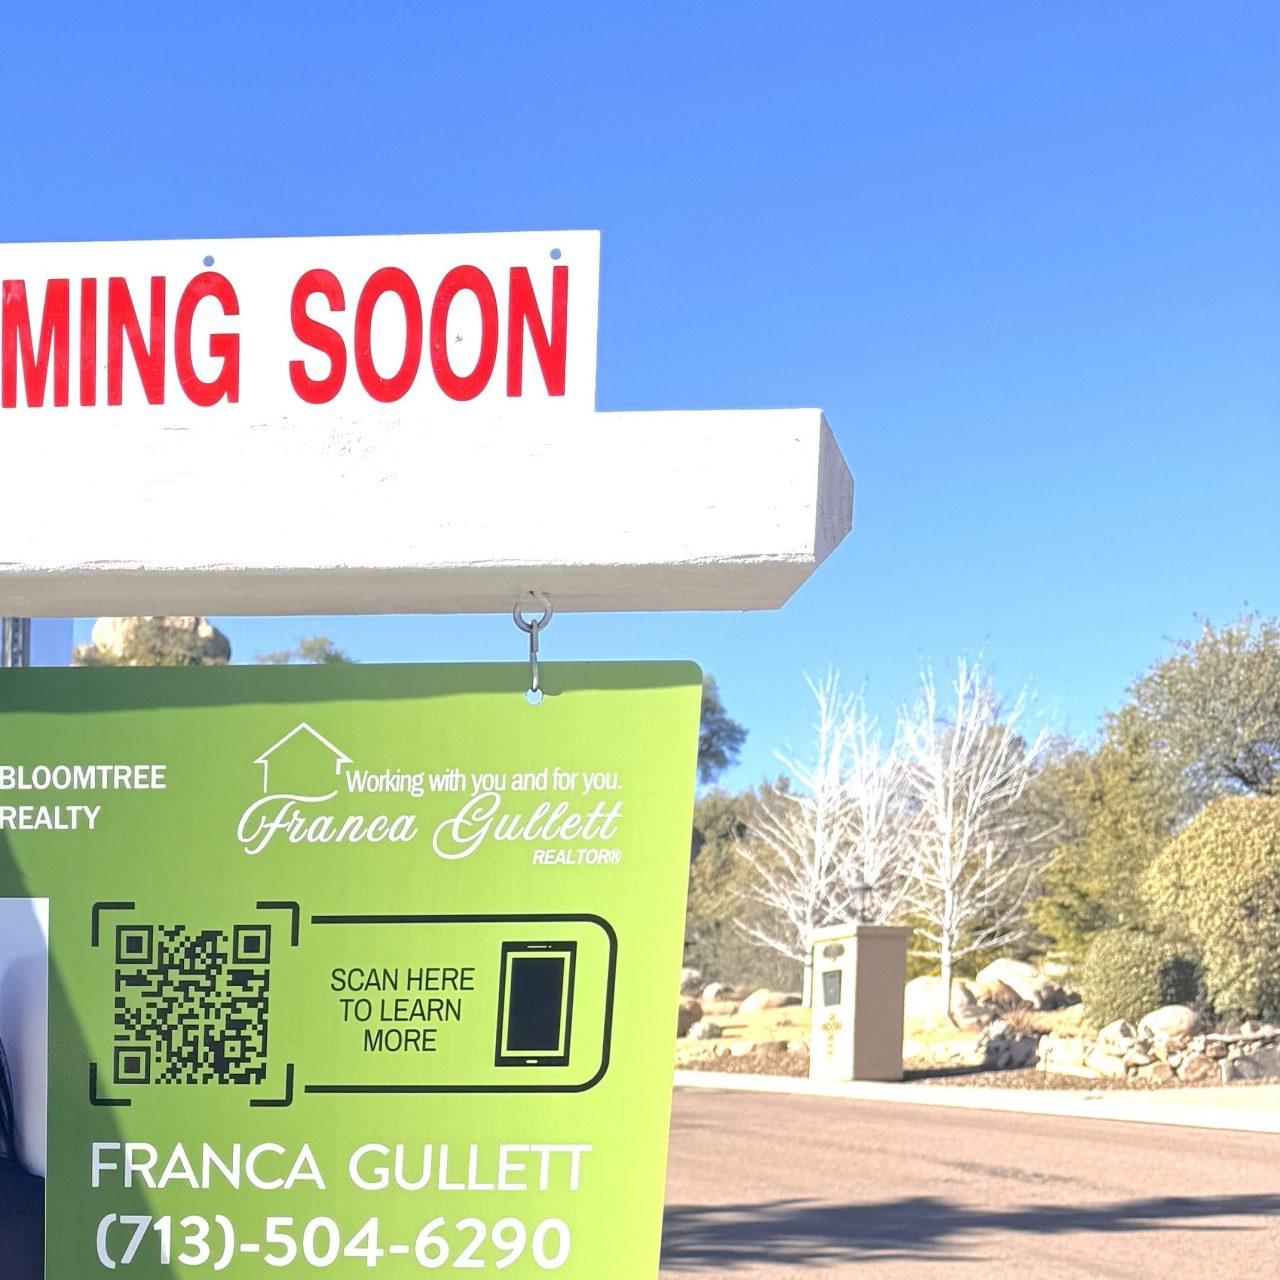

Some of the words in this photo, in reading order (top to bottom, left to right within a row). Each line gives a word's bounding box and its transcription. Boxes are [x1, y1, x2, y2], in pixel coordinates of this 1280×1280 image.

[289, 264, 570, 404] SOON
[345, 768, 425, 797] Working
[429, 768, 466, 792] with
[471, 773, 508, 798] you
[512, 767, 548, 791] and
[552, 767, 579, 790] for
[582, 772, 622, 796] you.
[237, 794, 419, 855] Franca
[432, 791, 624, 860] Gullett
[330, 968, 399, 992] SCAN
[407, 967, 476, 991] HERE
[339, 998, 372, 1022] TO
[380, 998, 462, 1022] LEARN
[363, 1029, 438, 1052] MORE
[90, 1142, 327, 1191] FRANCA
[348, 1144, 593, 1192] GULLETT
[95, 1213, 572, 1270] (713)-504-6290
